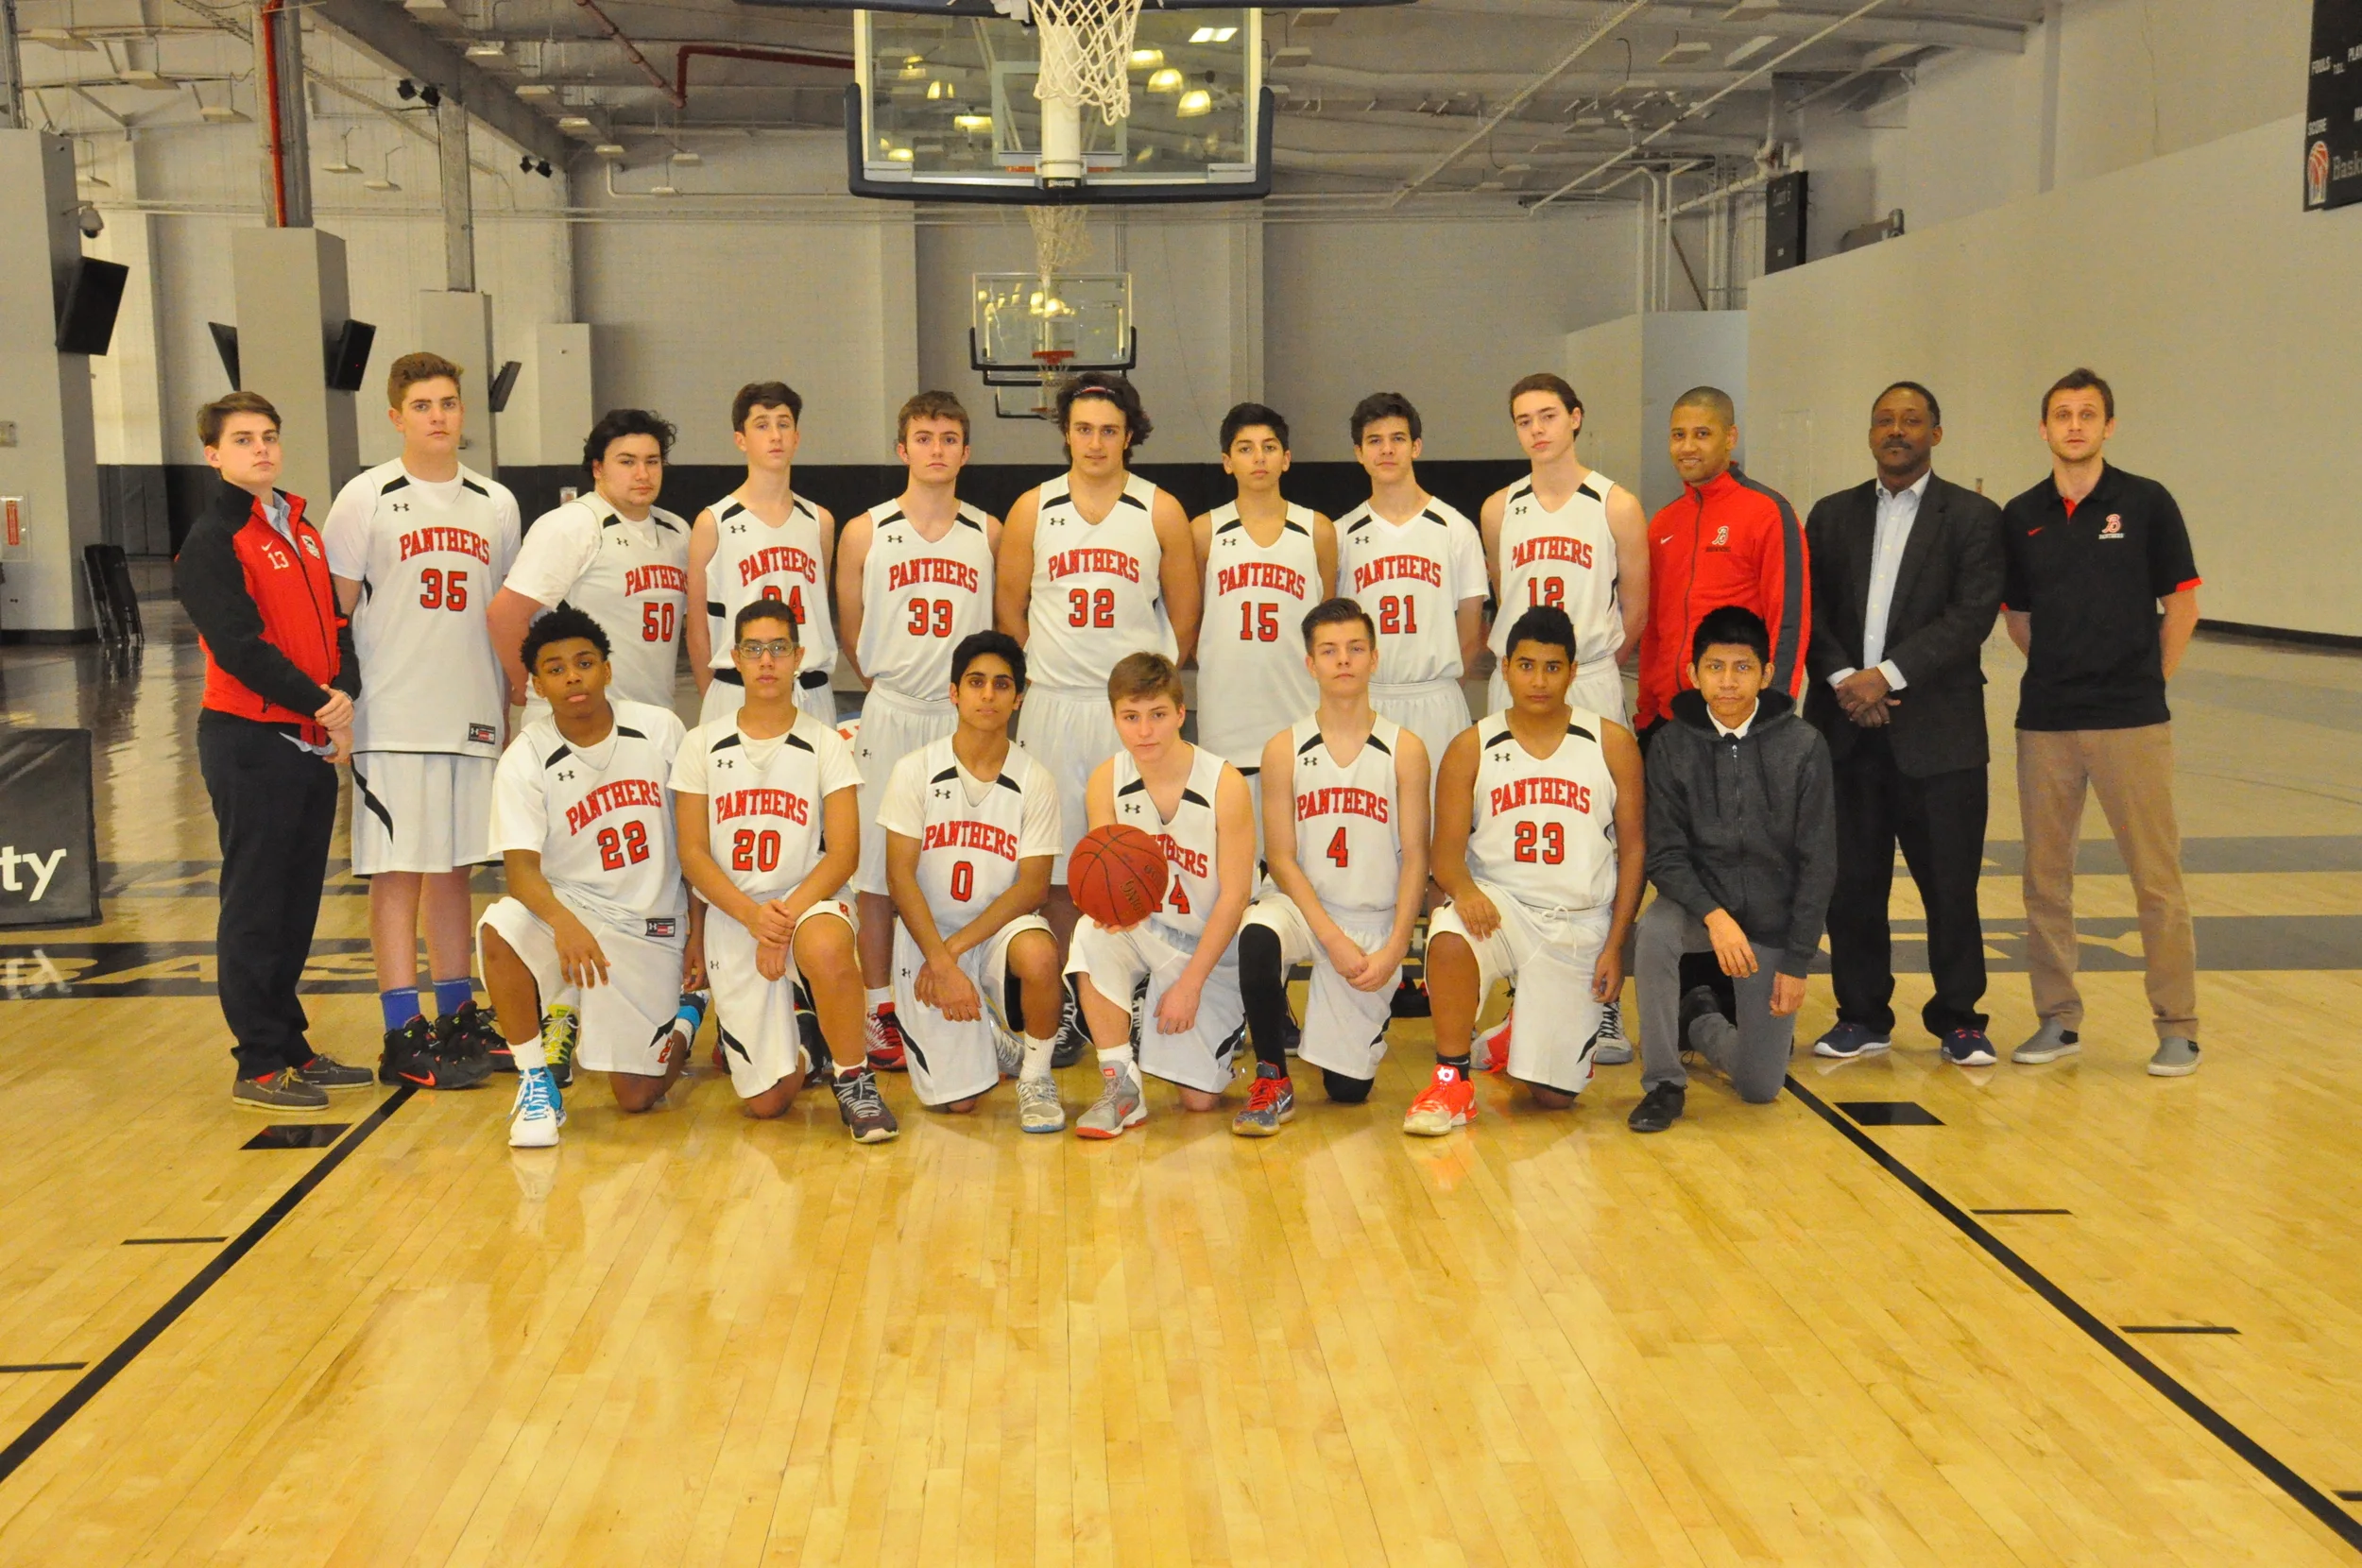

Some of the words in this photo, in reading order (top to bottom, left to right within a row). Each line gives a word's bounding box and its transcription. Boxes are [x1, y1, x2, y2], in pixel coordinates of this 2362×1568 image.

[2308, 118, 2327, 136] SCORE
[267, 551, 290, 570] 13
[400, 527, 489, 565] PANTHERS
[1049, 548, 1139, 584] PANTHERS
[738, 546, 816, 588] PANTHERS
[889, 558, 979, 593] PANTHERS
[1218, 562, 1306, 601] PANTHERS
[1354, 554, 1442, 594] PANTHERS
[419, 568, 468, 612] 35
[1069, 588, 1115, 628] 32
[1527, 576, 1565, 610] 12
[642, 602, 675, 642] 50
[908, 598, 953, 638] 33
[1240, 601, 1278, 642] 15
[1379, 595, 1417, 635] 21
[565, 778, 662, 837] PANTHERS
[715, 788, 809, 827] PANTHERS
[1296, 787, 1389, 825] PANTHERS
[1490, 776, 1591, 817] PANTHERS
[596, 820, 650, 872] 22
[732, 828, 781, 873] 20
[922, 820, 1018, 862] PANTHERS
[1326, 827, 1349, 868] 4
[1515, 821, 1565, 865] 23
[950, 861, 975, 902] 0
